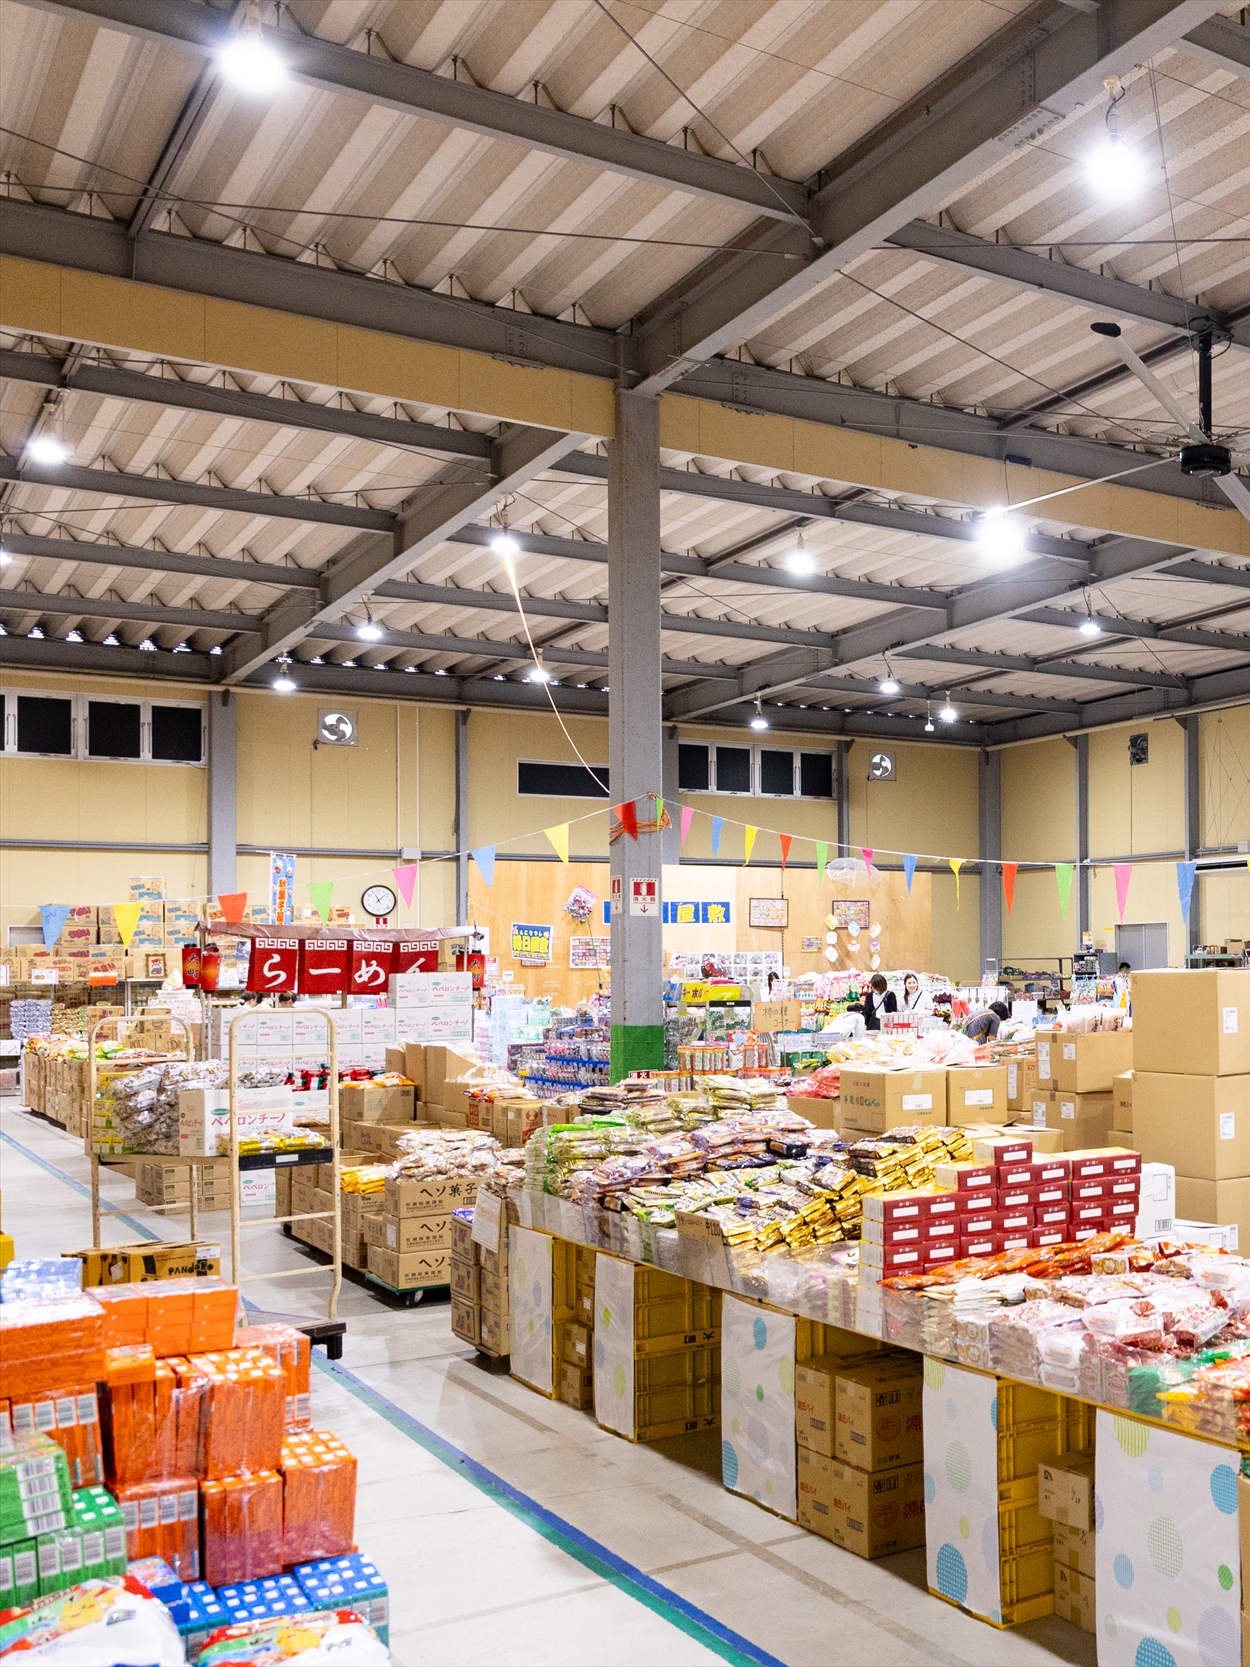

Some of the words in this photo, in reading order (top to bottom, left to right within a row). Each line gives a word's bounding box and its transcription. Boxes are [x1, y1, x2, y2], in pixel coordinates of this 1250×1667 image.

[677, 904, 725, 923] 屋敷
[187, 953, 199, 979] 大町
[470, 959, 481, 983] 大町
[762, 1006, 789, 1018] 柿の種
[773, 1019, 796, 1028] コーナー
[420, 1182, 478, 1197] ヘソ菓子
[420, 1221, 451, 1233] ヘソ
[418, 1256, 451, 1268] ヘソ
